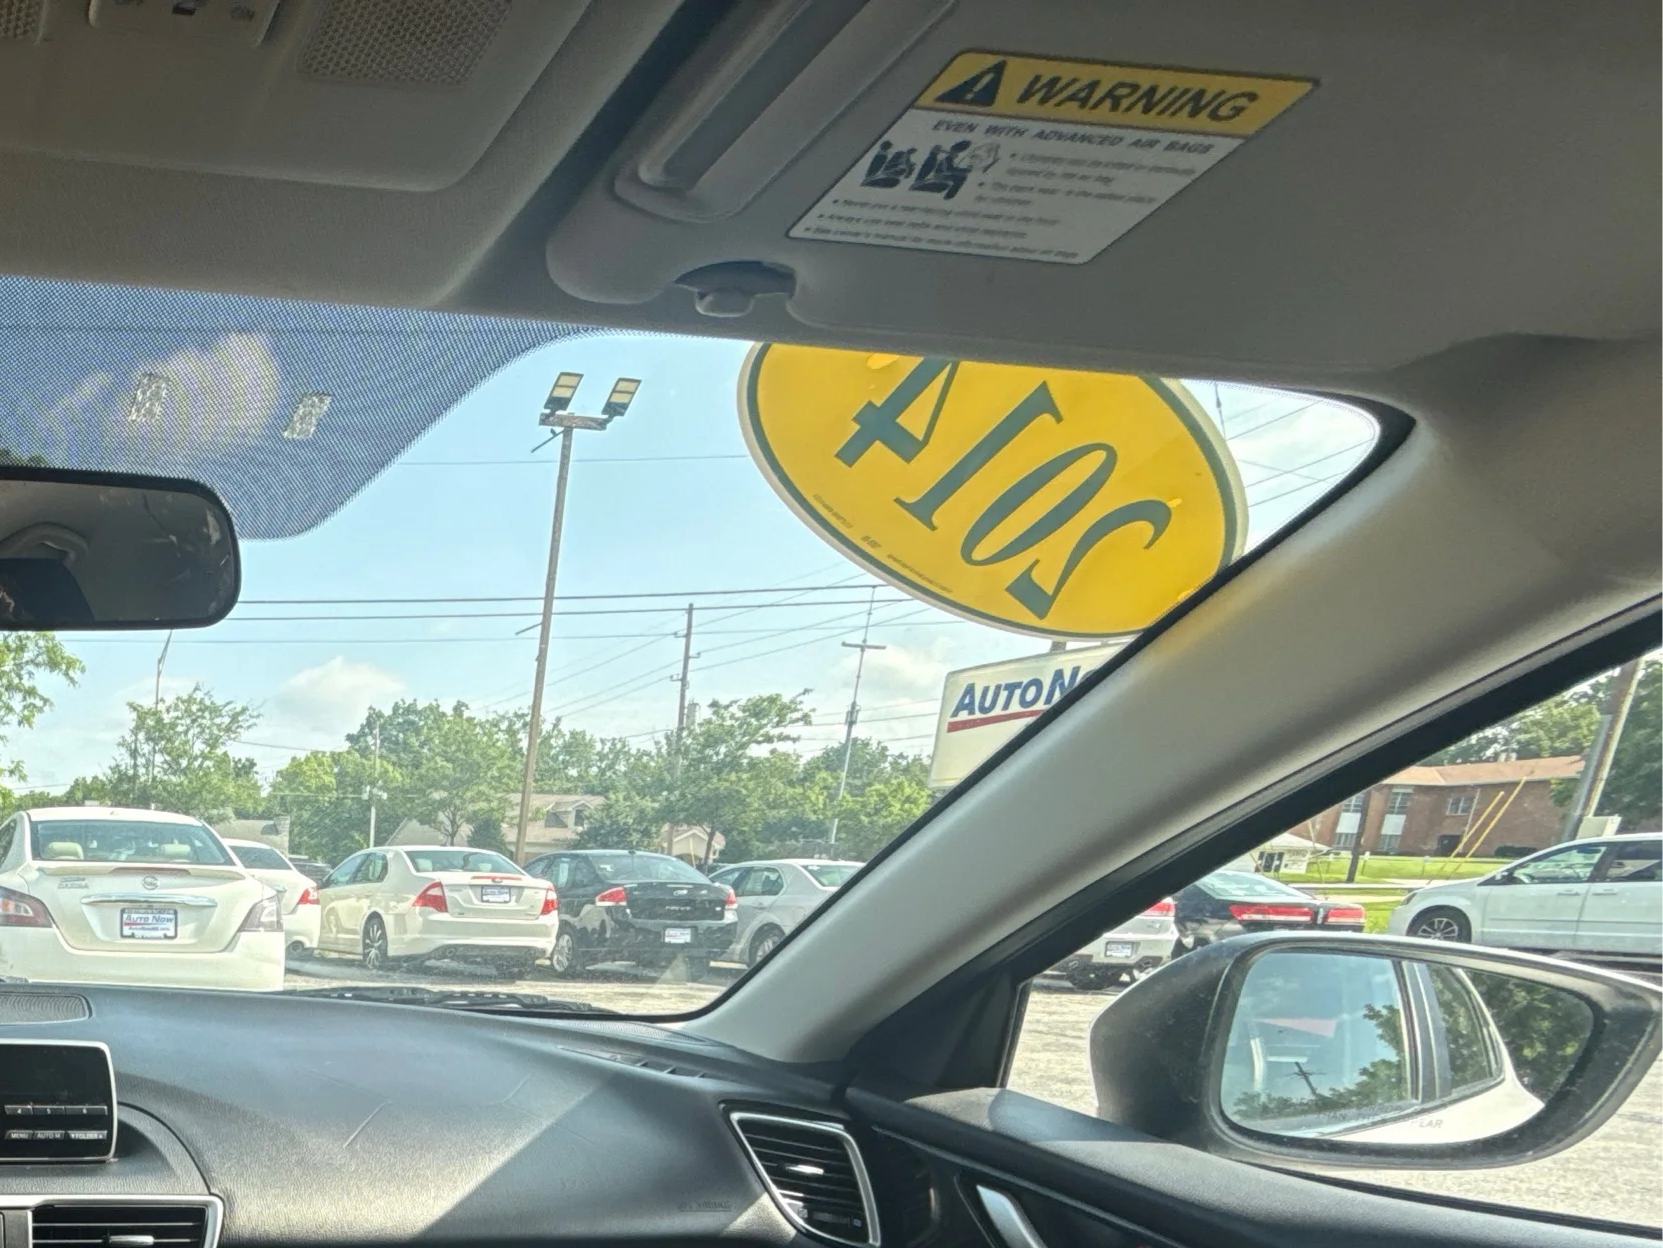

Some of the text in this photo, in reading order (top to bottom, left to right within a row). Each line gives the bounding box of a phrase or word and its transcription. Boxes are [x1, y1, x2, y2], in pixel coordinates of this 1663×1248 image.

[1017, 73, 1259, 122] WARNING
[932, 119, 978, 133] EVEN
[984, 124, 1029, 138] WITH
[1033, 128, 1125, 147] ADVANCED
[1127, 137, 1161, 149] AIR
